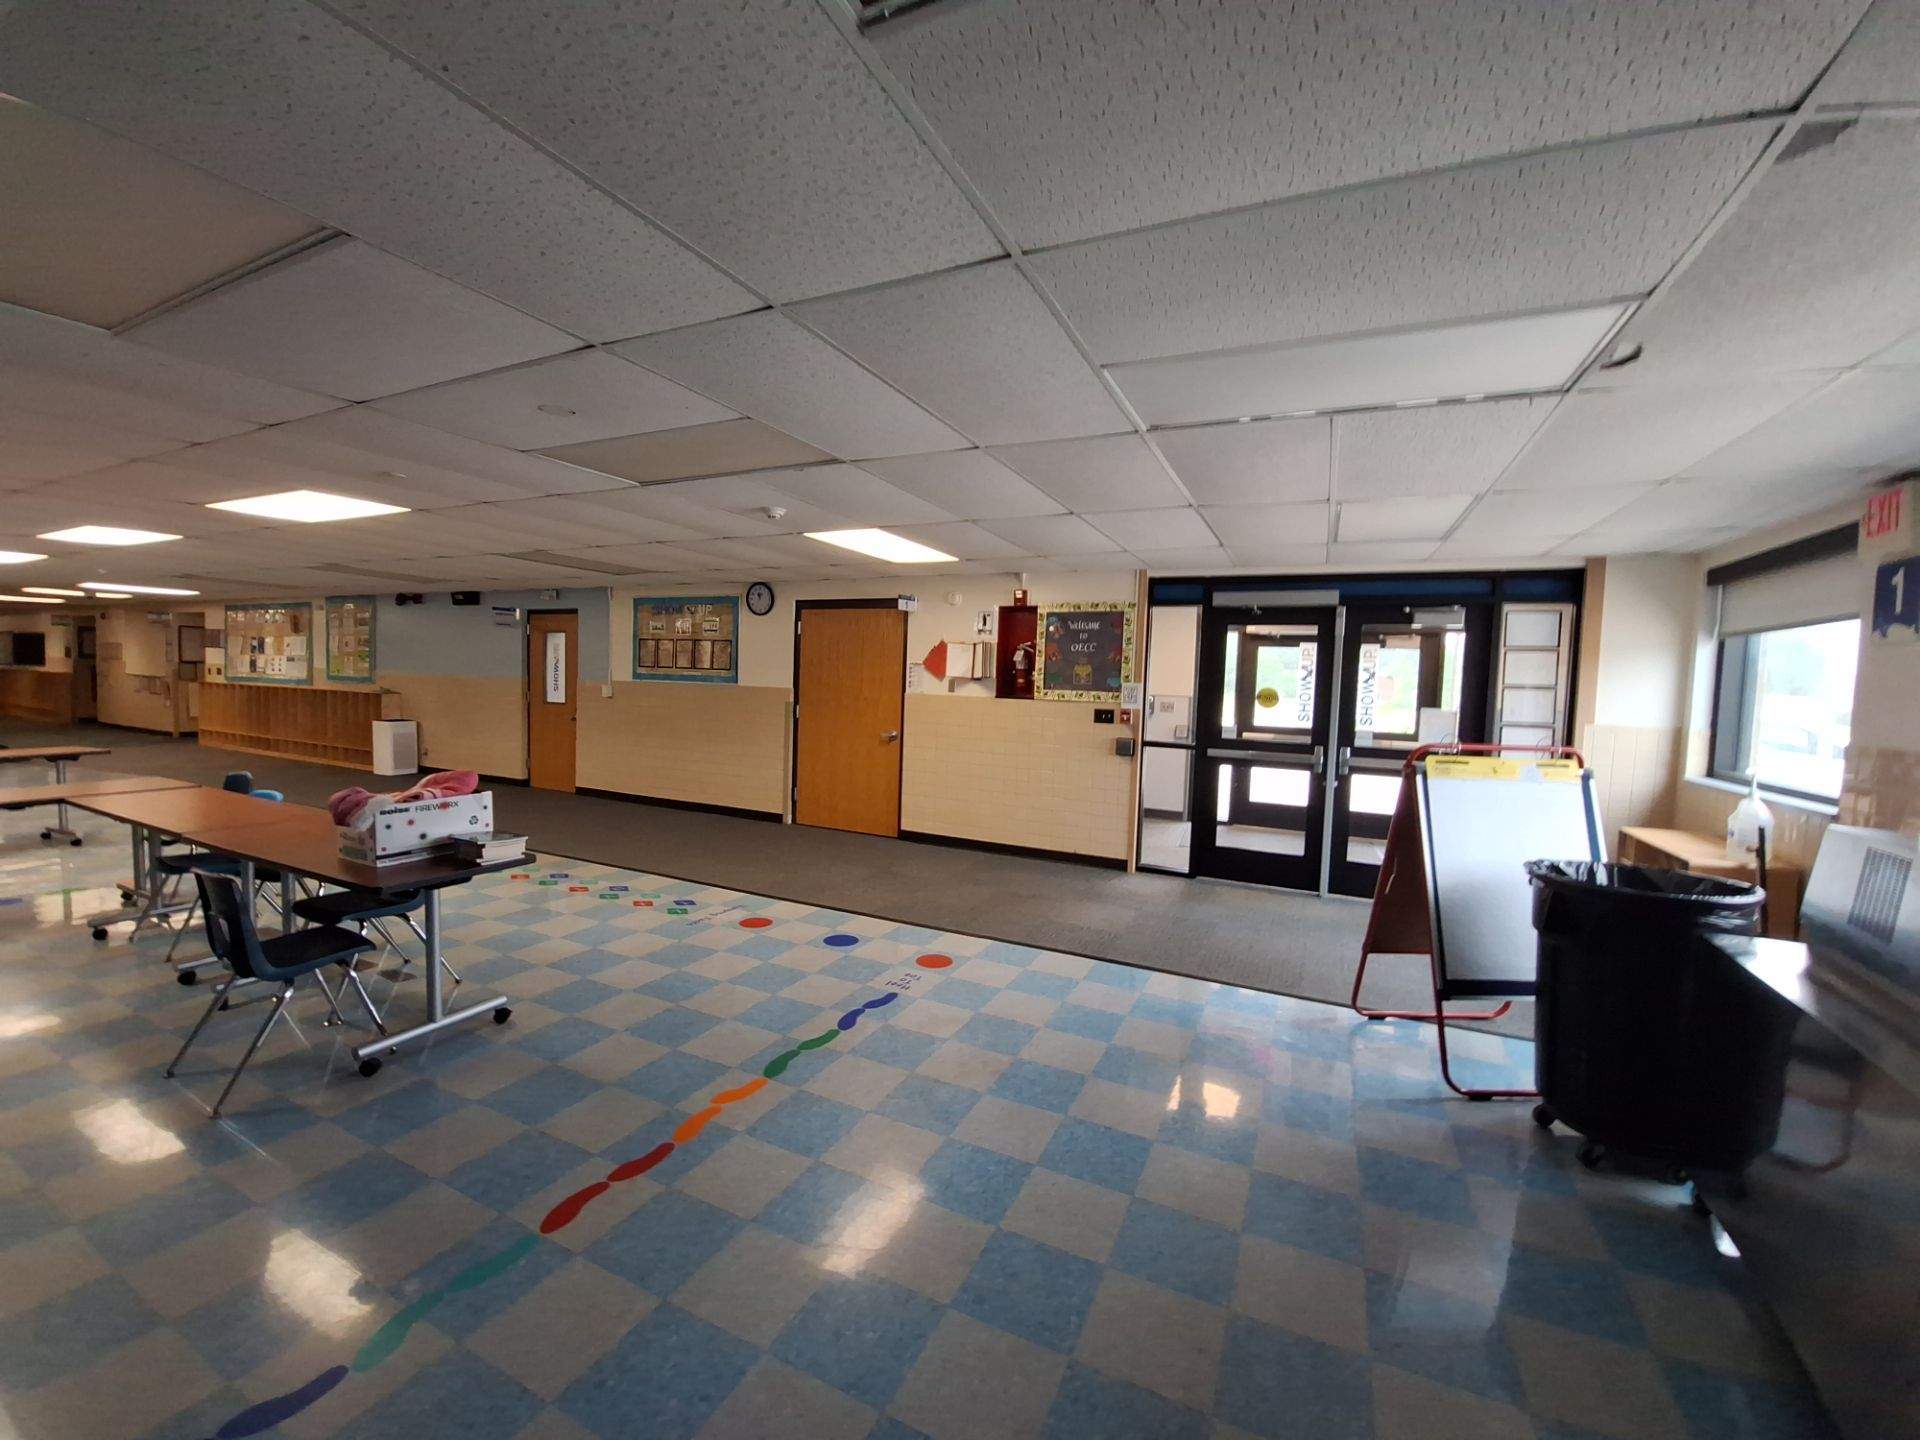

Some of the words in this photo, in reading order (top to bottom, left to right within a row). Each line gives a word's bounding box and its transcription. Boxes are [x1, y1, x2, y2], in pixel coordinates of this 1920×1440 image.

[1866, 490, 1902, 538] EXIT
[1891, 567, 1905, 616] 1
[1067, 619, 1101, 631] Welcome
[1070, 642, 1097, 652] OECC
[1298, 678, 1312, 722] SHOW
[1360, 679, 1375, 727] SHOW
